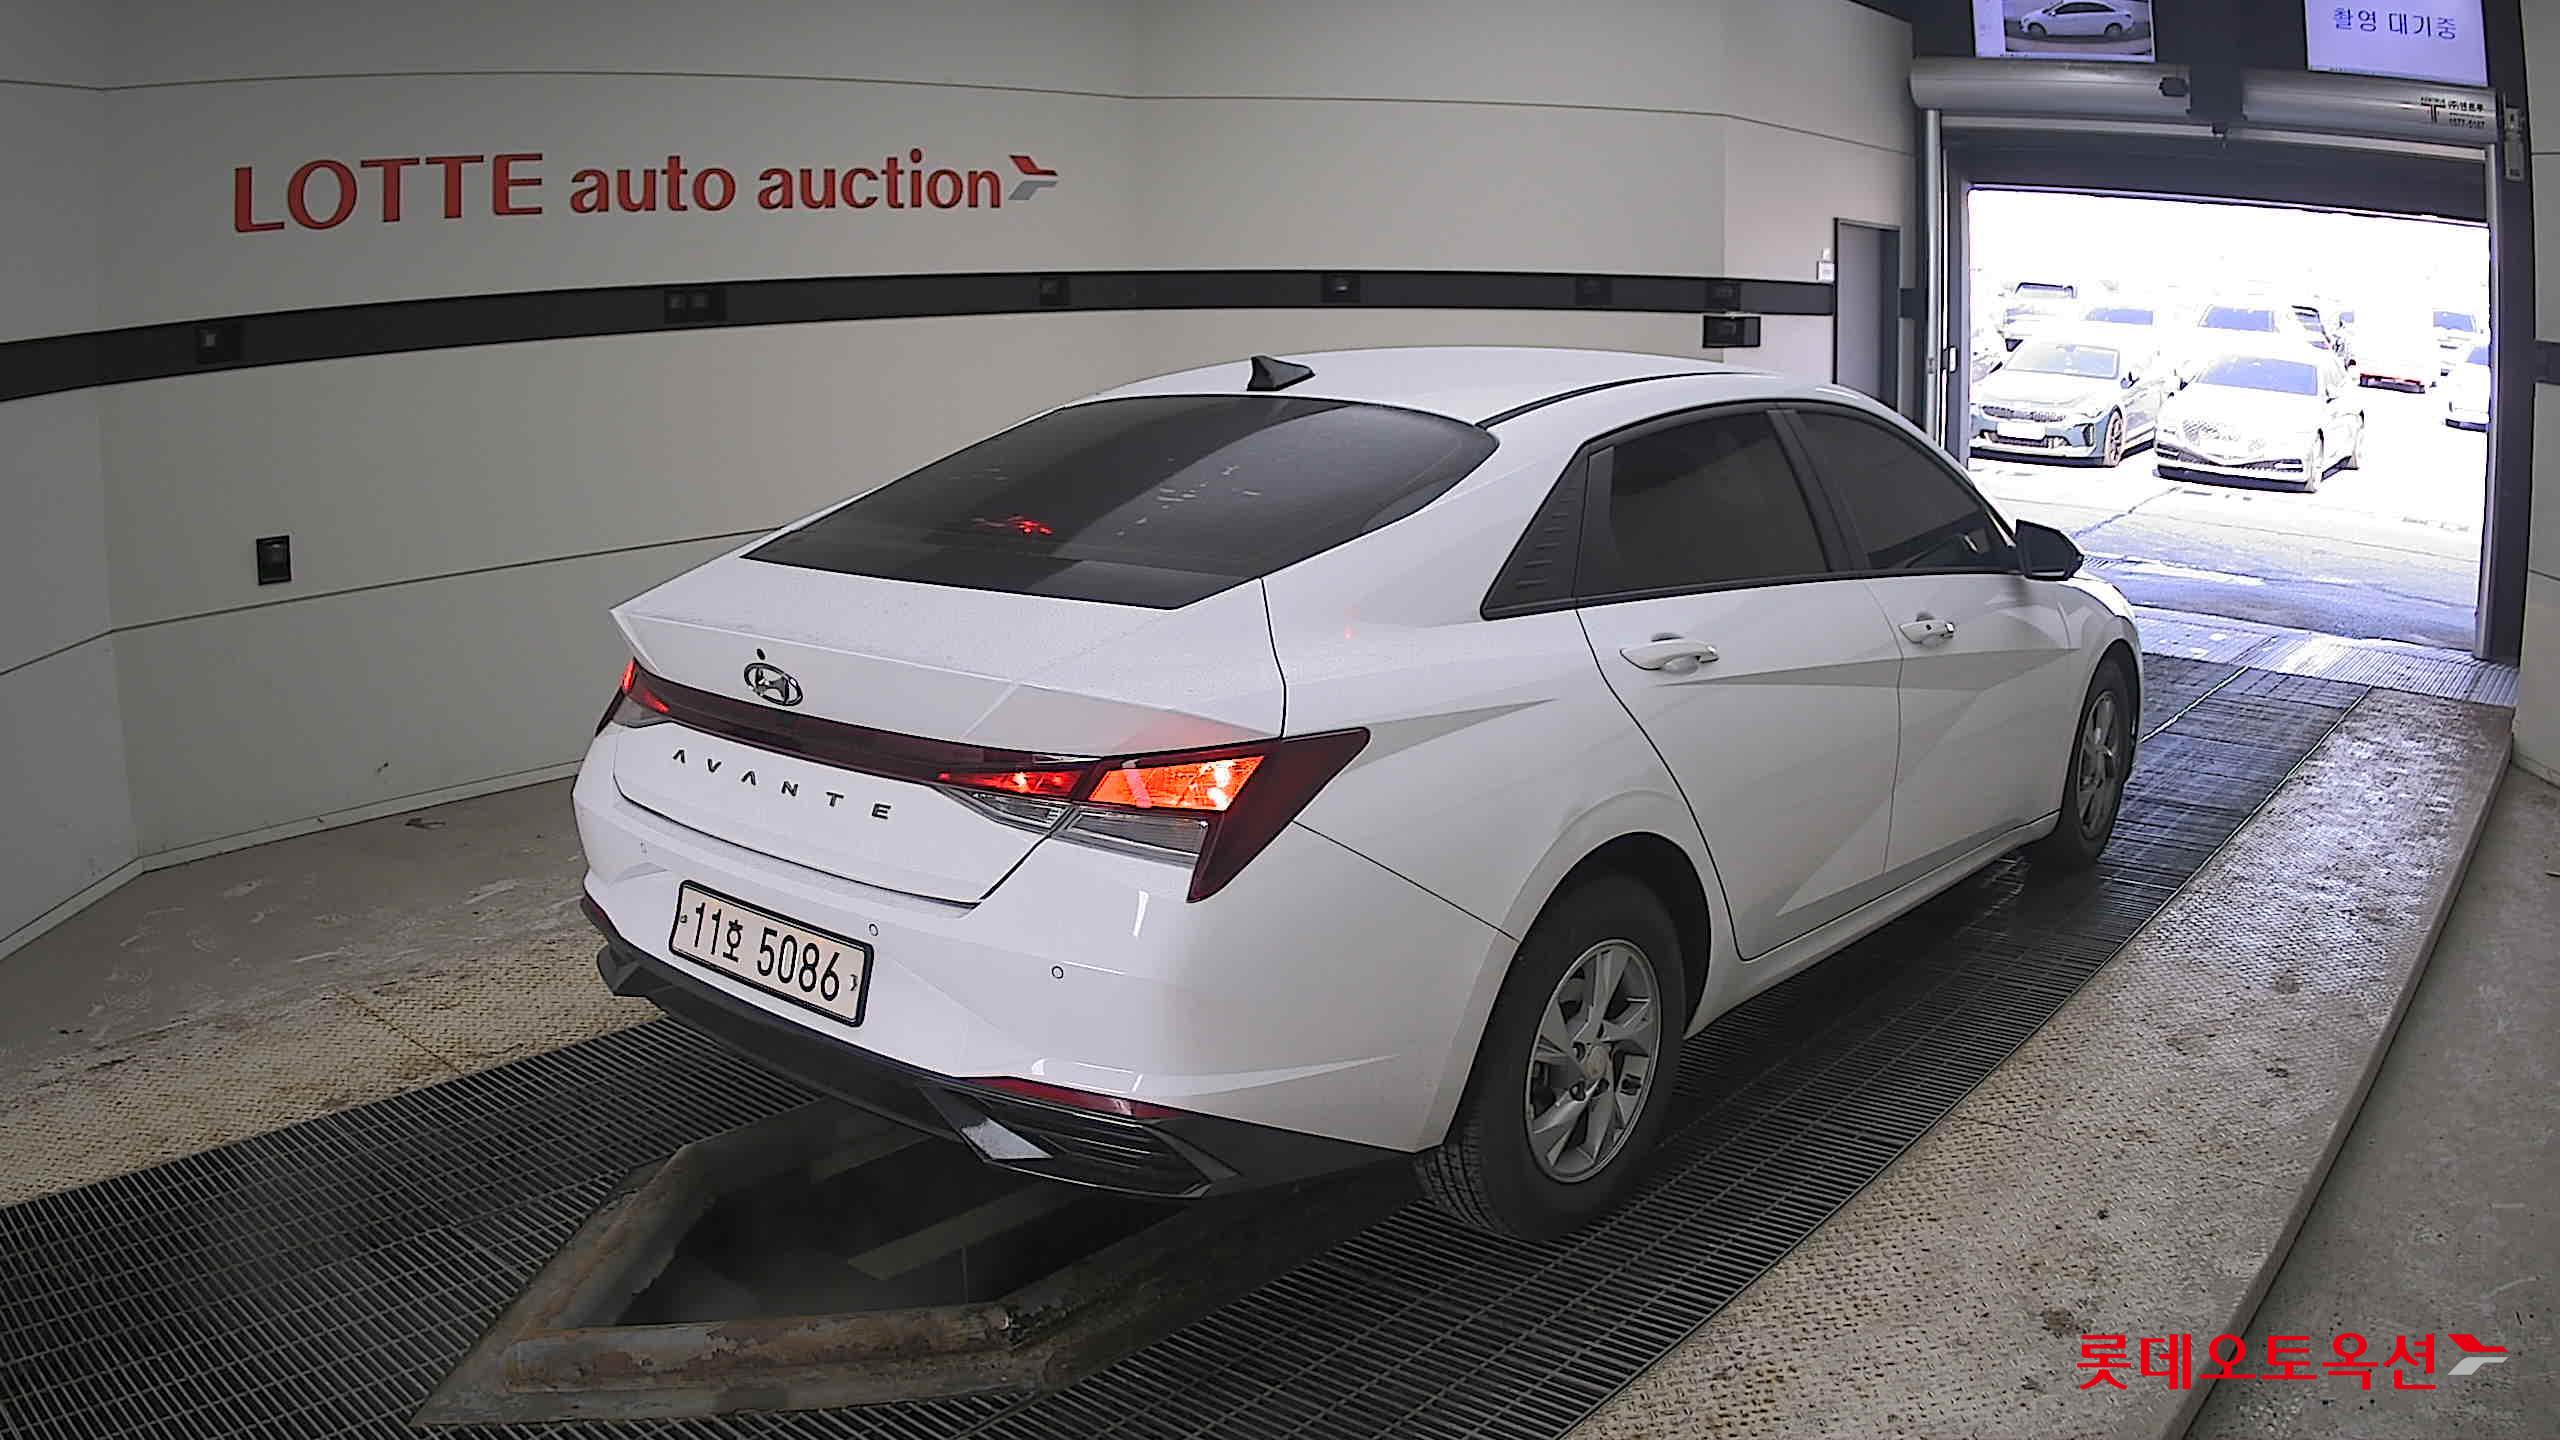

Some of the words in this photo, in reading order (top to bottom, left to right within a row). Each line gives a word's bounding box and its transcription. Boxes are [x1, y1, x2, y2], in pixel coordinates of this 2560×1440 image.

[2335, 7, 2377, 32] 촬영
[2388, 12, 2456, 40] 대기중
[234, 153, 543, 233] LOTTE
[570, 155, 736, 213] auto
[757, 148, 1001, 210] auction
[673, 749, 892, 819] AVANTE
[694, 902, 743, 962] 11호
[757, 927, 840, 1001] 5086
